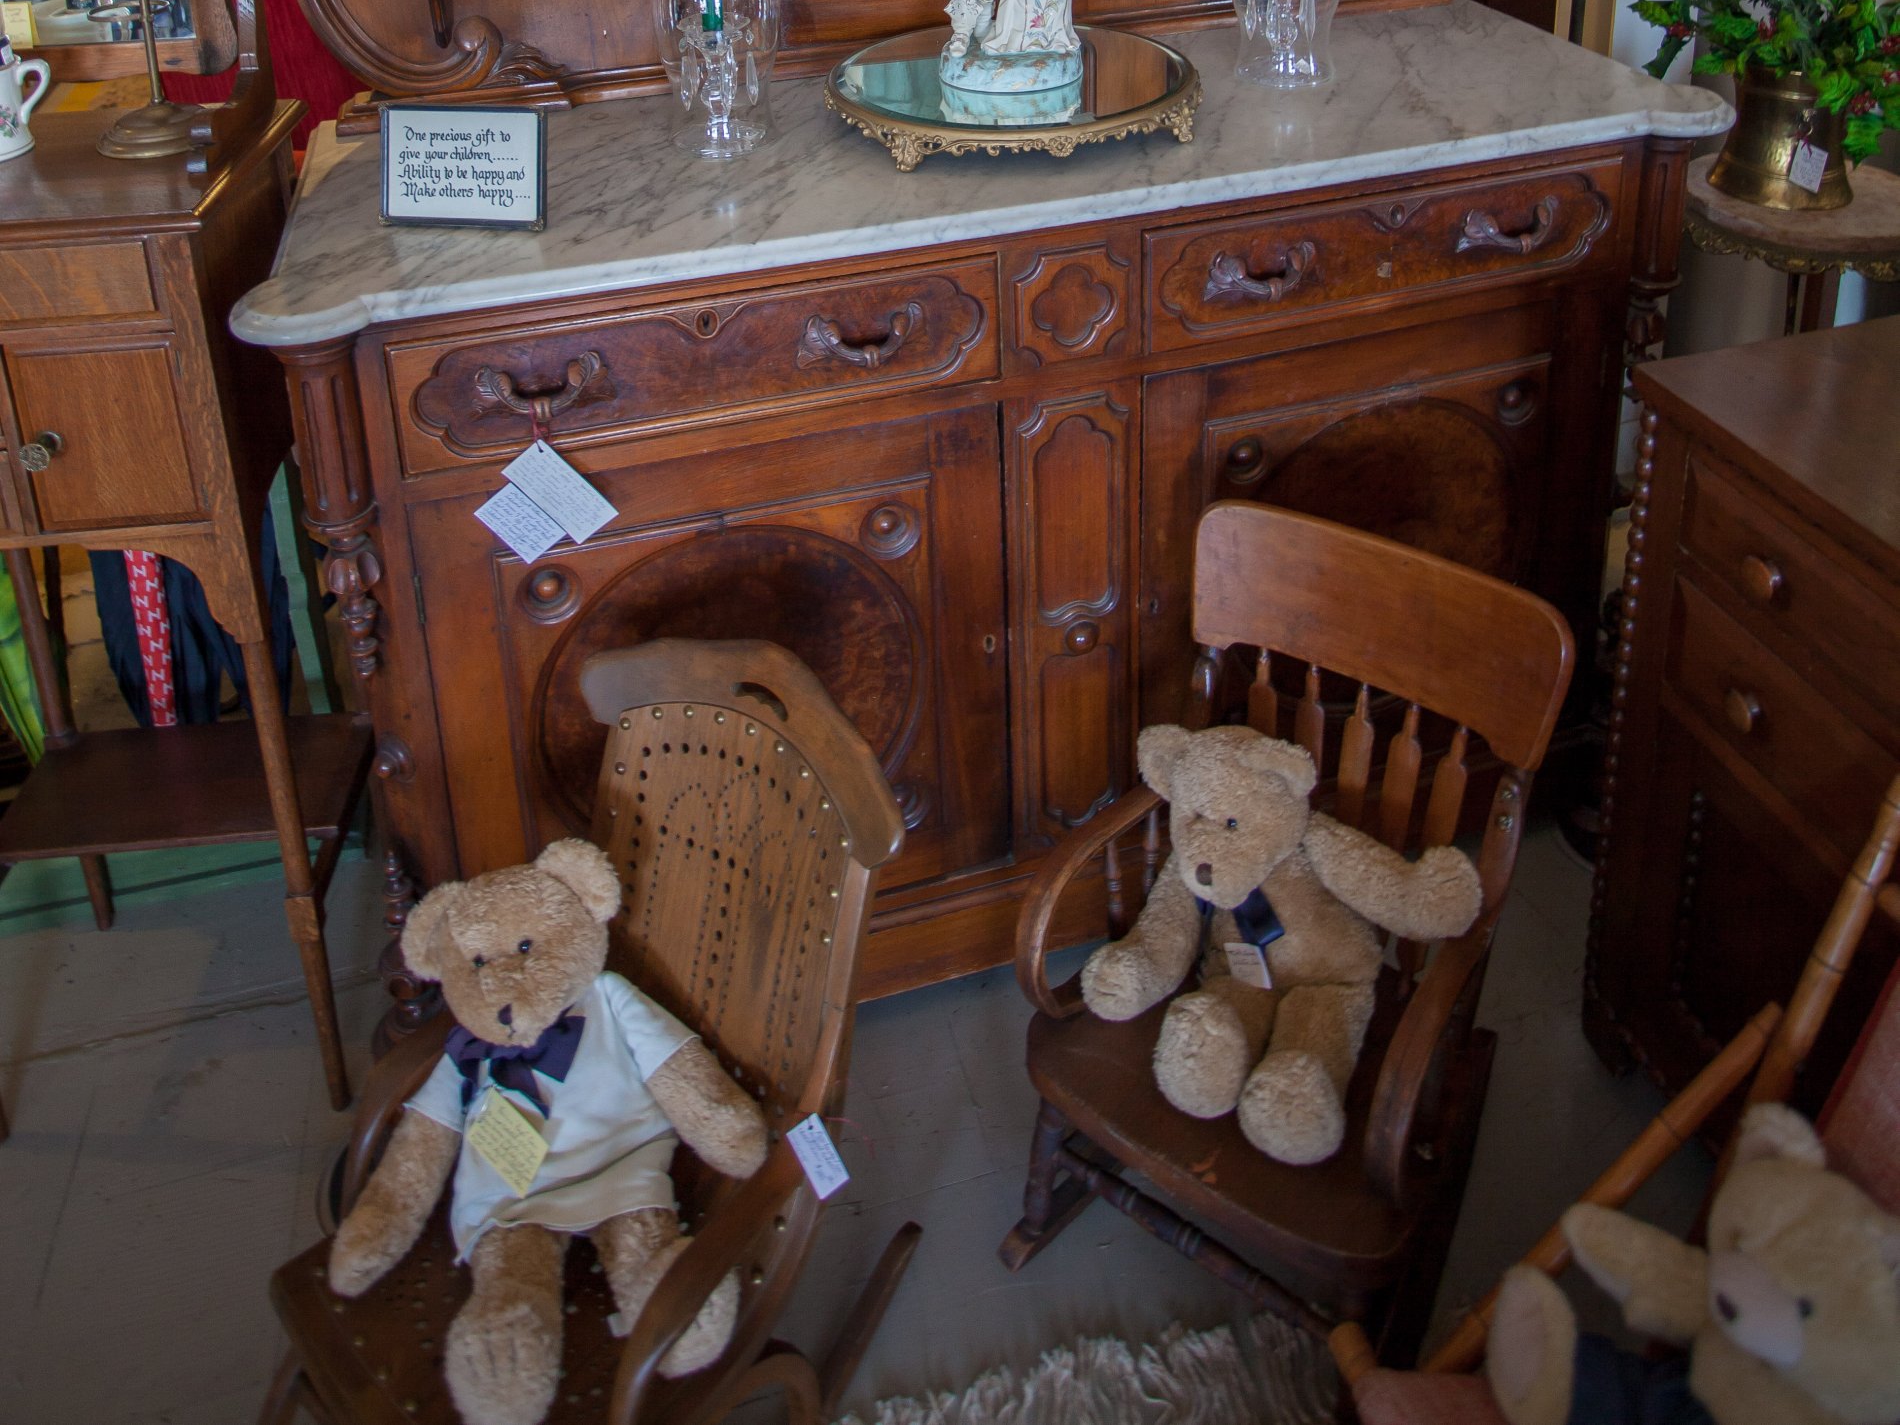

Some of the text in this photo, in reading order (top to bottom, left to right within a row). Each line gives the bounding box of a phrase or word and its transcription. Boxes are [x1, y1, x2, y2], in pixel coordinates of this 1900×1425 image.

[403, 126, 511, 147] One precious gift to
[398, 146, 421, 164] give
[424, 151, 448, 164] your
[397, 164, 525, 185] Ability to be happy and
[400, 181, 437, 203] Make
[439, 182, 475, 198] others
